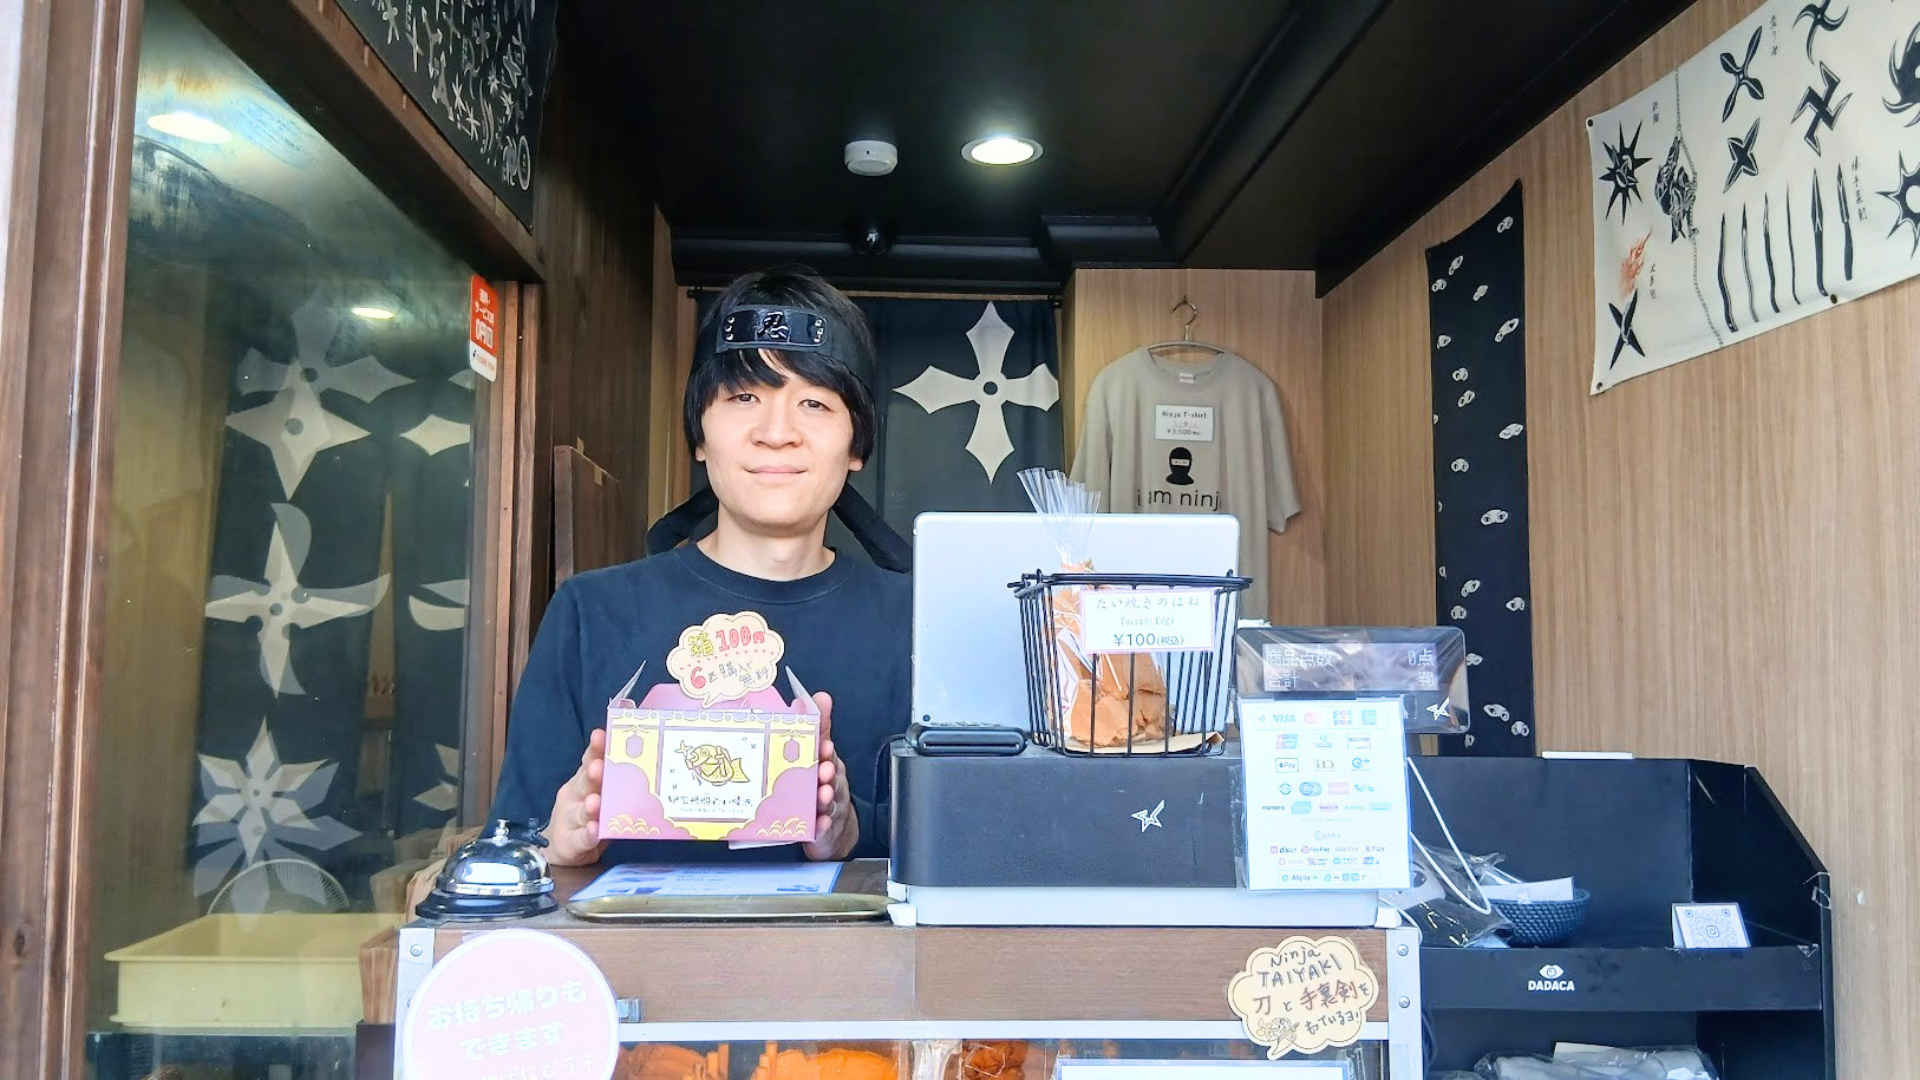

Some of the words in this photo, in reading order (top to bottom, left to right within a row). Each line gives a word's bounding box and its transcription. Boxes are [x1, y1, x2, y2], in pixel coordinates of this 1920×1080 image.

[1180, 490, 1222, 512] ninj
[1155, 616, 1176, 626] Edge
[1266, 648, 1333, 668] 商品点数
[1267, 670, 1299, 689] 合計
[1273, 713, 1296, 723] VISA
[1270, 946, 1321, 968] Ninja
[1256, 953, 1343, 988] TAIYAKI
[1527, 980, 1575, 992] DADACA
[427, 979, 589, 1030] お持ち帰りも
[458, 1020, 566, 1061] できます
